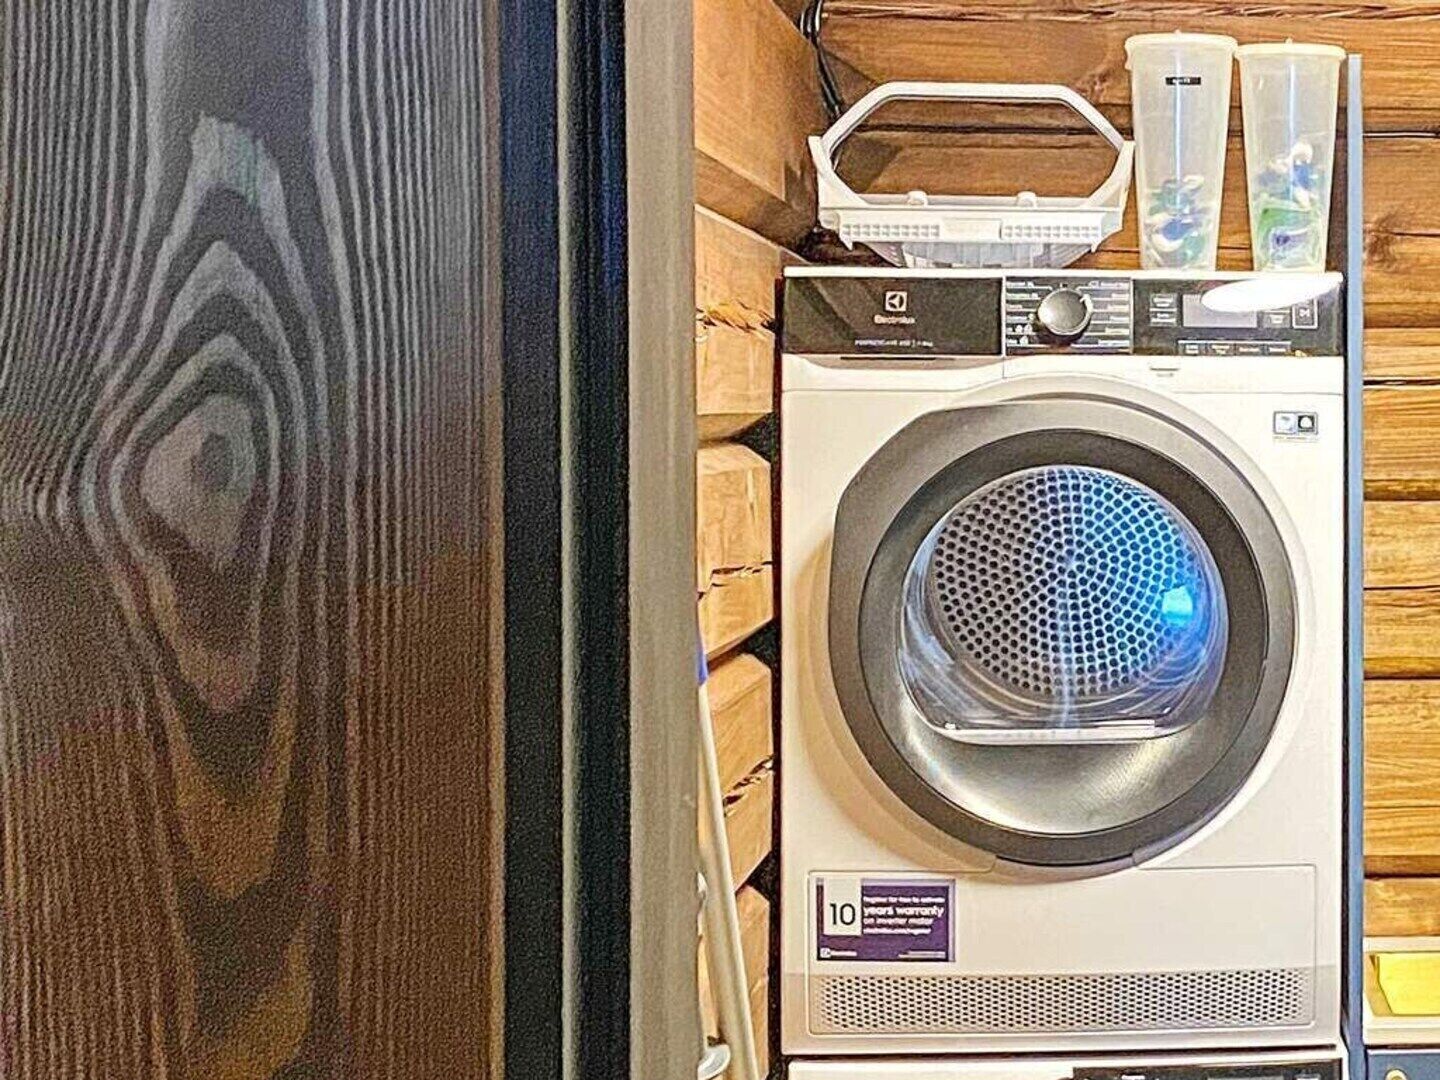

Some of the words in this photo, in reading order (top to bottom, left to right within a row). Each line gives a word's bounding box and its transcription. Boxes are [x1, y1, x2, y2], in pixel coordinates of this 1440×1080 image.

[830, 902, 856, 926] 10
[863, 905, 894, 917] years
[895, 905, 945, 918] warranty
